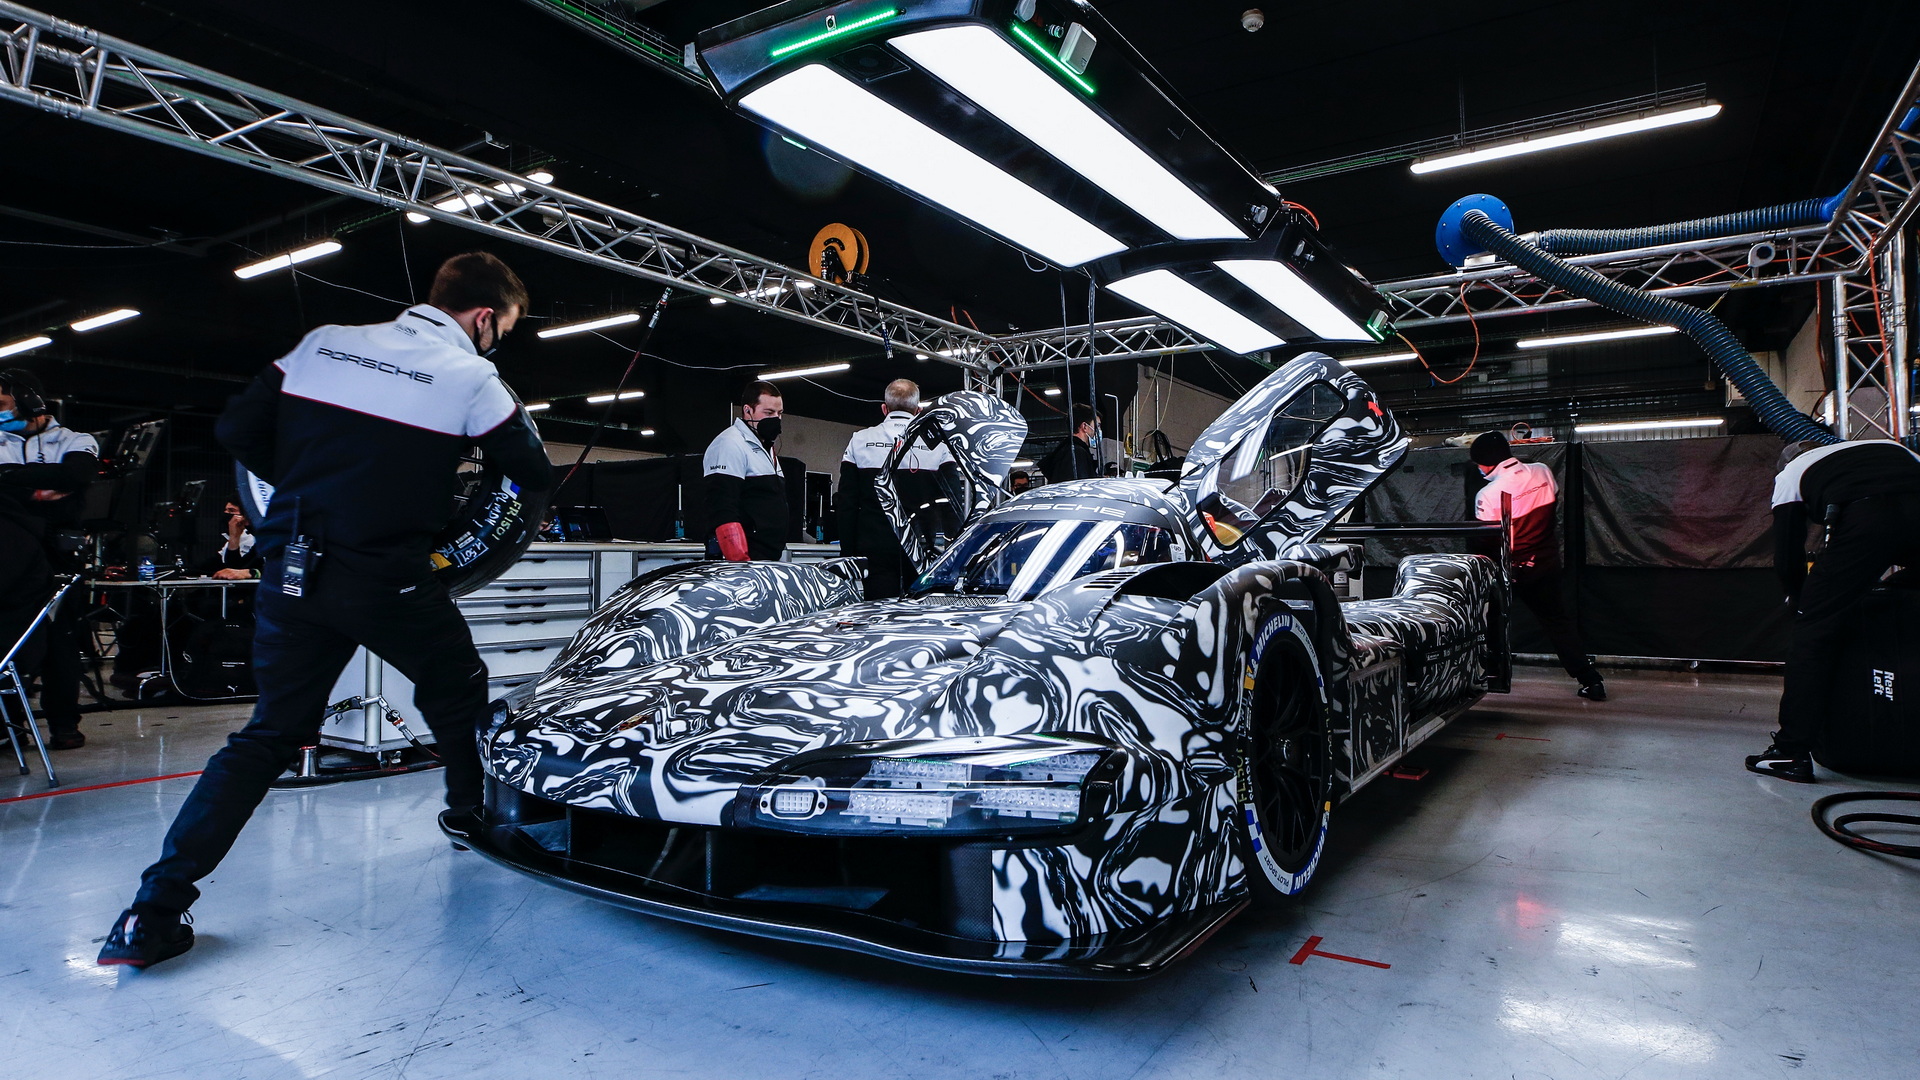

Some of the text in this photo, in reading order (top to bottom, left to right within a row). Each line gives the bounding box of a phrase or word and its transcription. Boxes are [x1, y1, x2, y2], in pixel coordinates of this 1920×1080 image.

[316, 347, 434, 385] PORSCHE
[865, 441, 930, 451] PORHE
[1255, 614, 1291, 661] MICHELIN
[1873, 668, 1884, 695] Left
[1884, 670, 1895, 701] Rear
[1263, 854, 1279, 878] SPORT
[1293, 830, 1325, 891] MICHELIN
